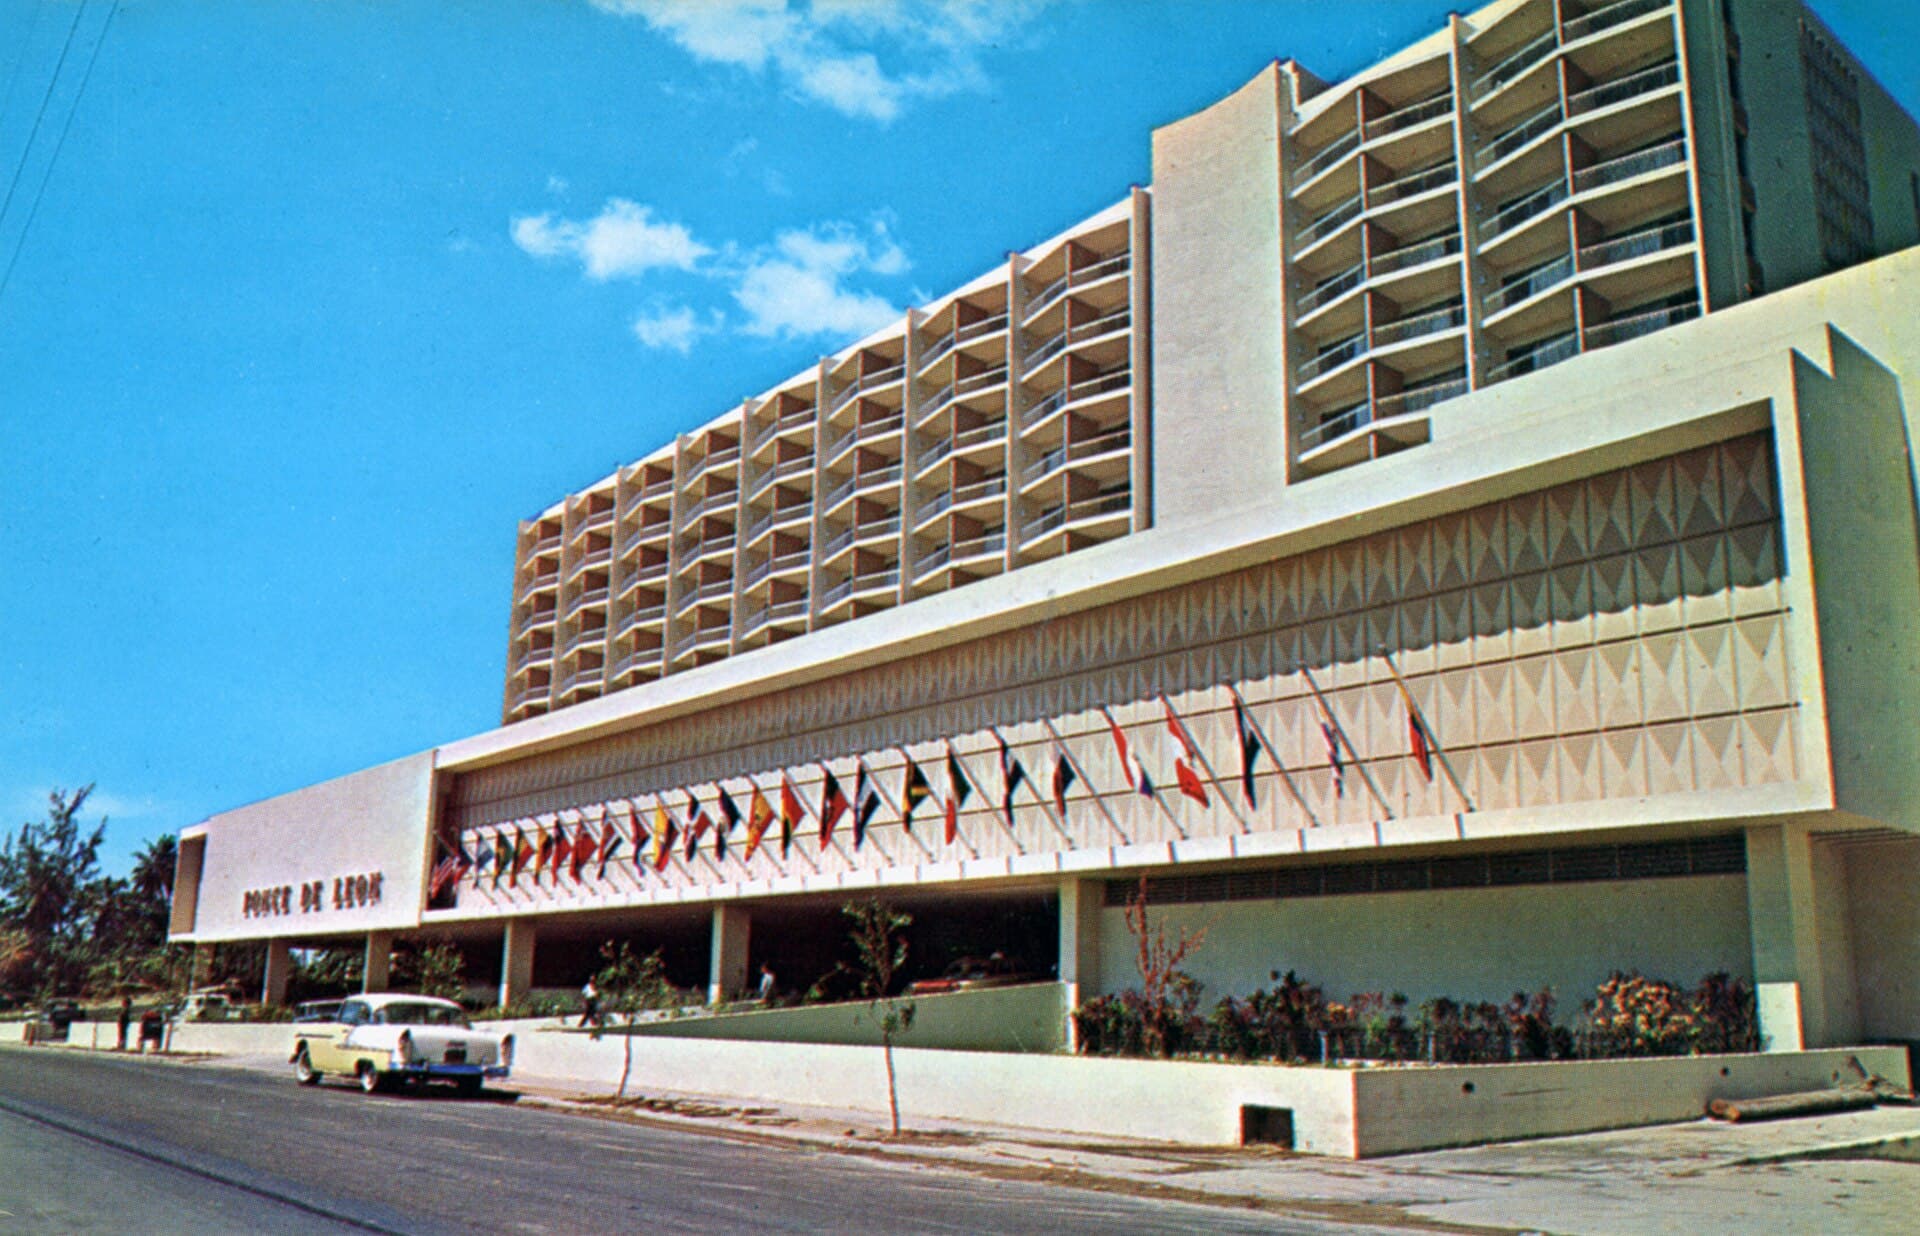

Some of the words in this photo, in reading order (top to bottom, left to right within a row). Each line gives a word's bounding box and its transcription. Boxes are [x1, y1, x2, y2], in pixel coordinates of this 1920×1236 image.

[243, 885, 292, 919] PONCE
[300, 880, 323, 914] DE
[333, 871, 383, 910] LEON
